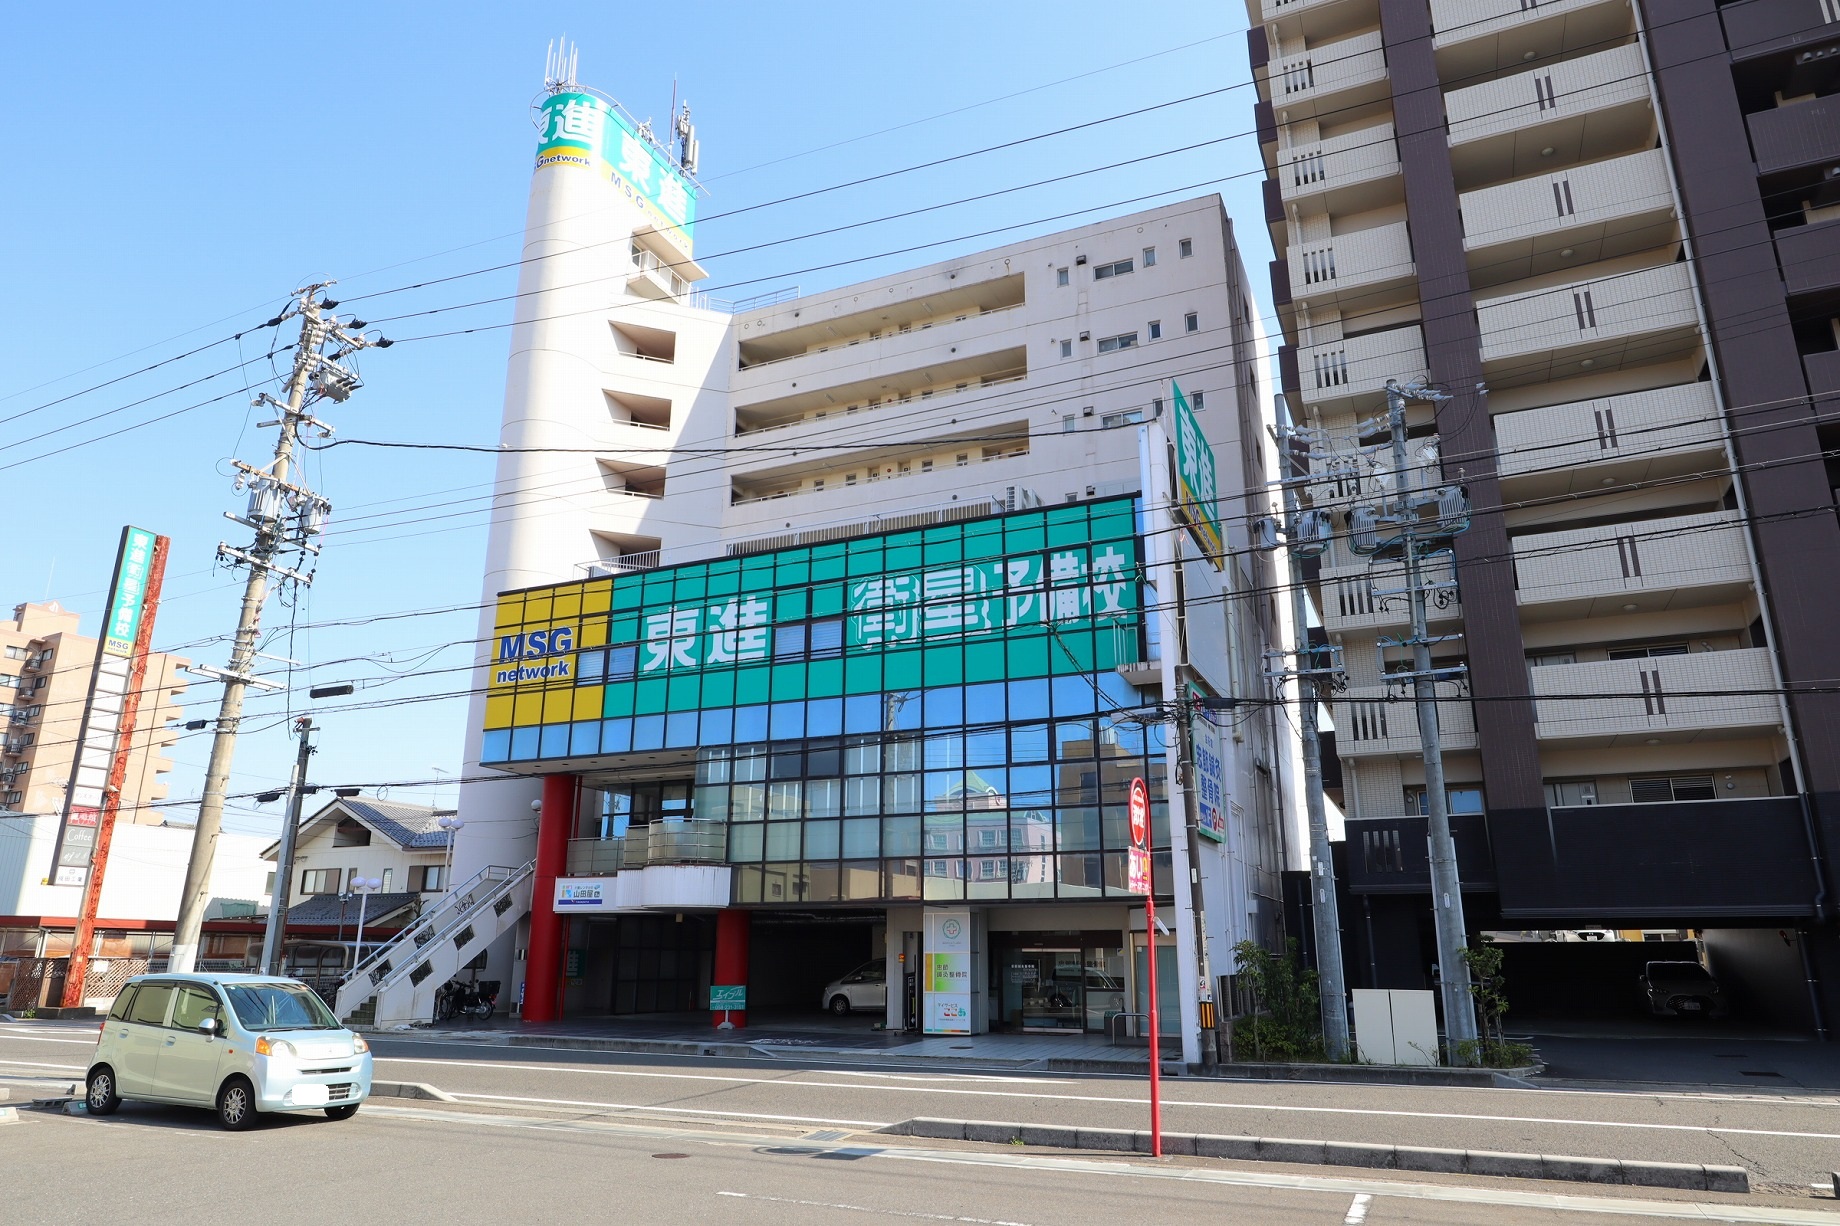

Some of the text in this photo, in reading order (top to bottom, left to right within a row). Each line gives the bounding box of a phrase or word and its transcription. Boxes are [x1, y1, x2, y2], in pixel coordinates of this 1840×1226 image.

[611, 172, 644, 208] MSG
[1179, 403, 1217, 527] 東進
[643, 545, 1130, 674] 東進 衛星予備校
[108, 639, 130, 650] MSG
[499, 626, 573, 663] MSG
[496, 660, 570, 684] network
[67, 828, 92, 843] Coffee
[713, 986, 744, 1000] エイブル
